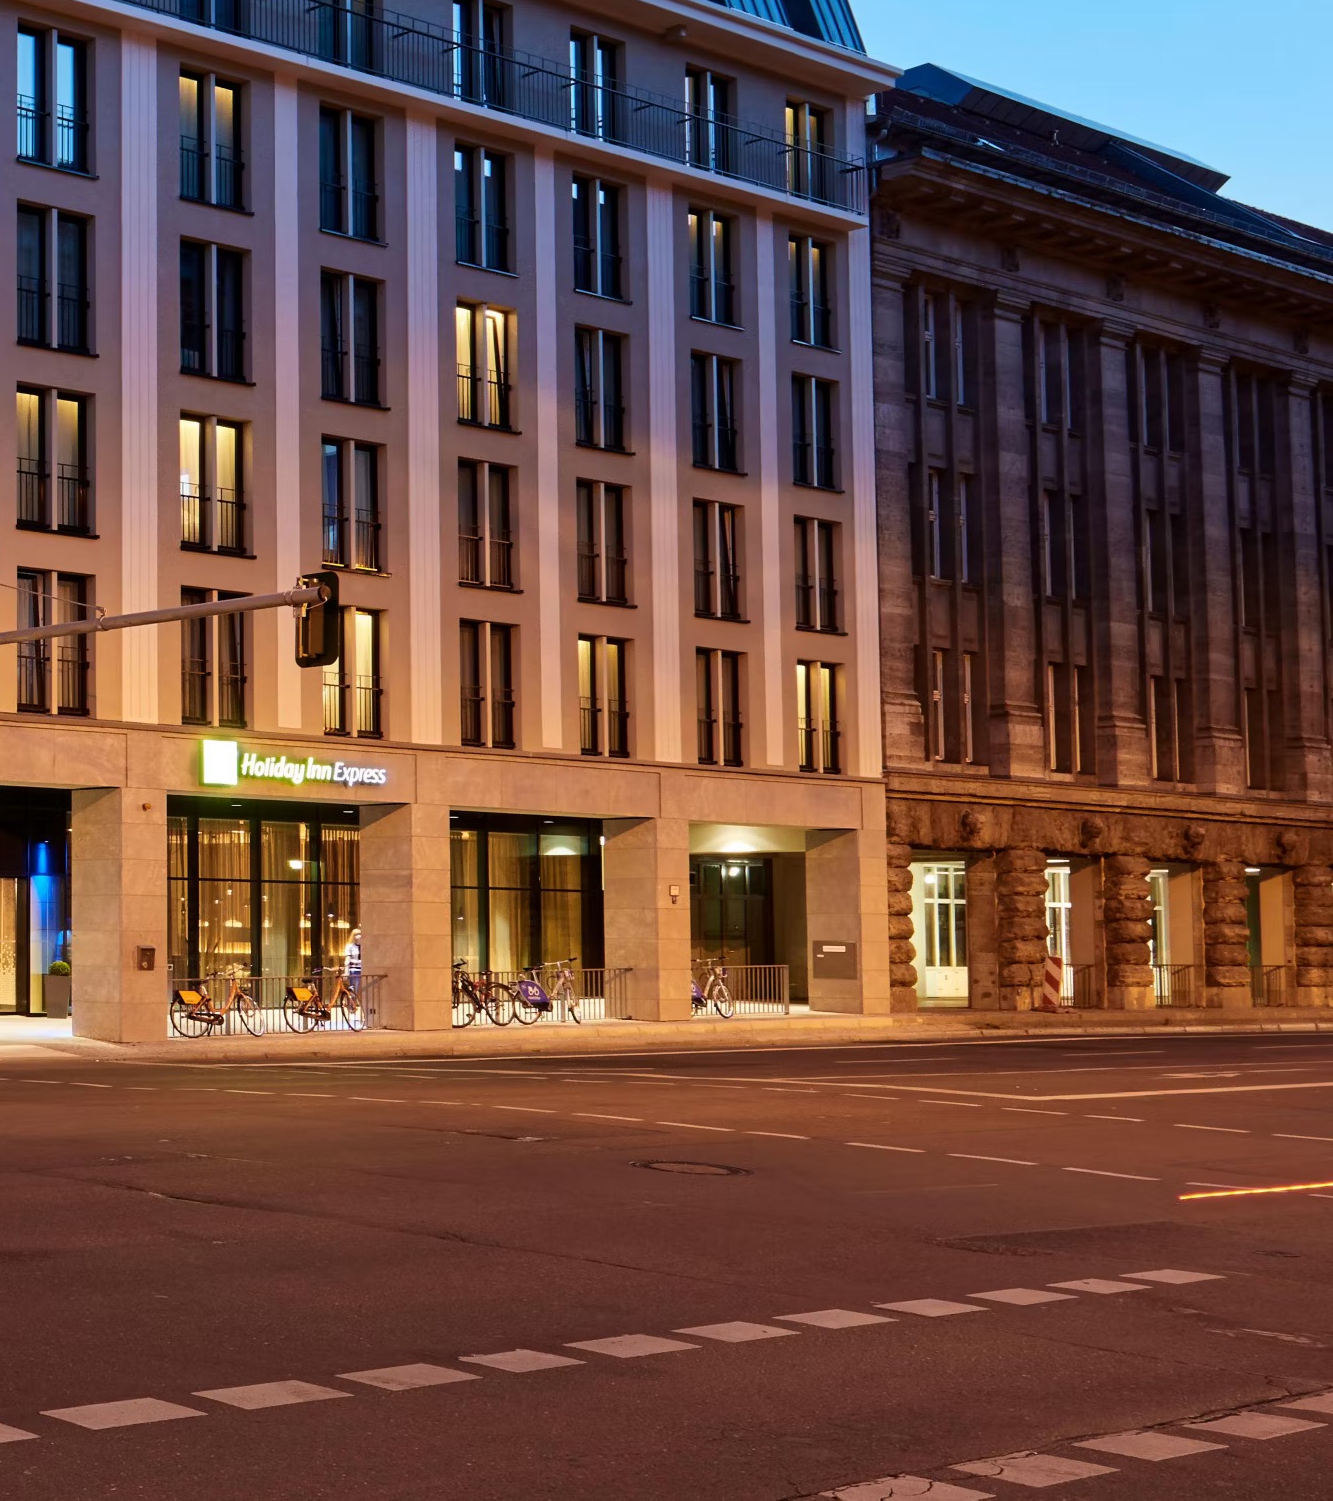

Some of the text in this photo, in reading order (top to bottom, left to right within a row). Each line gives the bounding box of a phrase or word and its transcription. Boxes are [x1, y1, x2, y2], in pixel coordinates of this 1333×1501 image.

[241, 752, 387, 786] Holiday Inn Express
